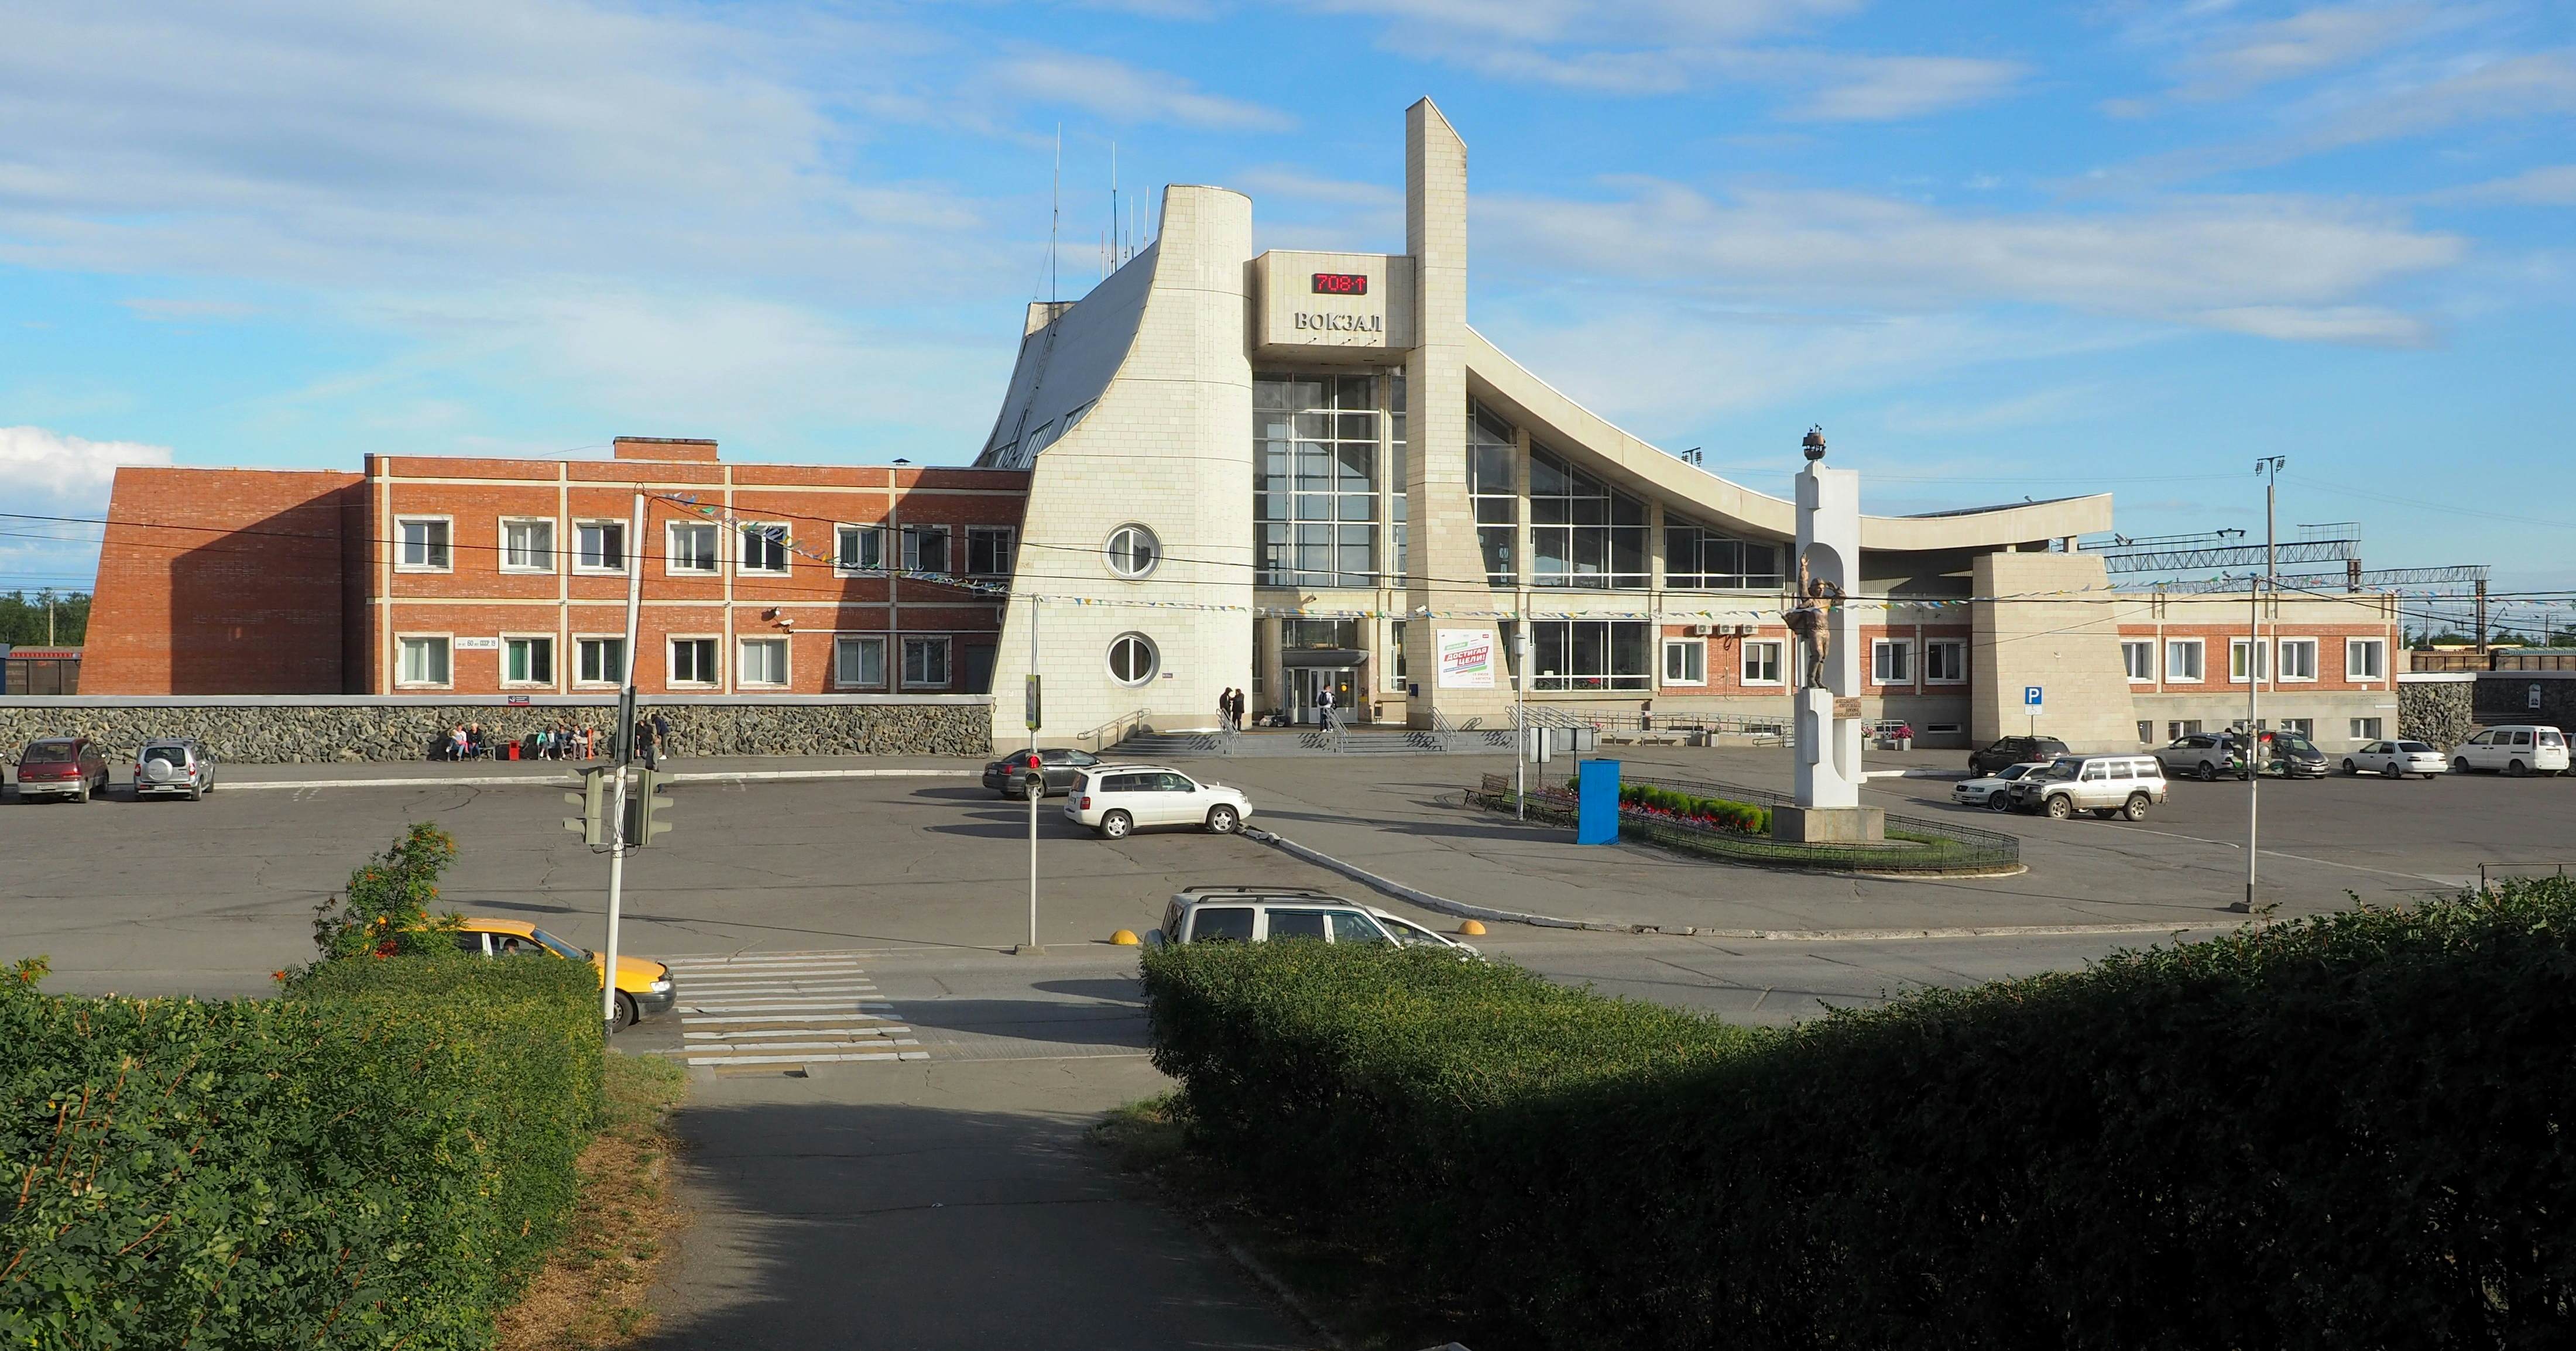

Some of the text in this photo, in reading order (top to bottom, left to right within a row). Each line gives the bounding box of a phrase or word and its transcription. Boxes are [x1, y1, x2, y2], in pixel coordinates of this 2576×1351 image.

[1295, 312, 1382, 332] ВОКЗАЛ
[1446, 647, 1487, 661] ДОСТИГАЯ
[1458, 654, 1486, 666] ЦЕЛИ!
[2029, 688, 2040, 704] P
